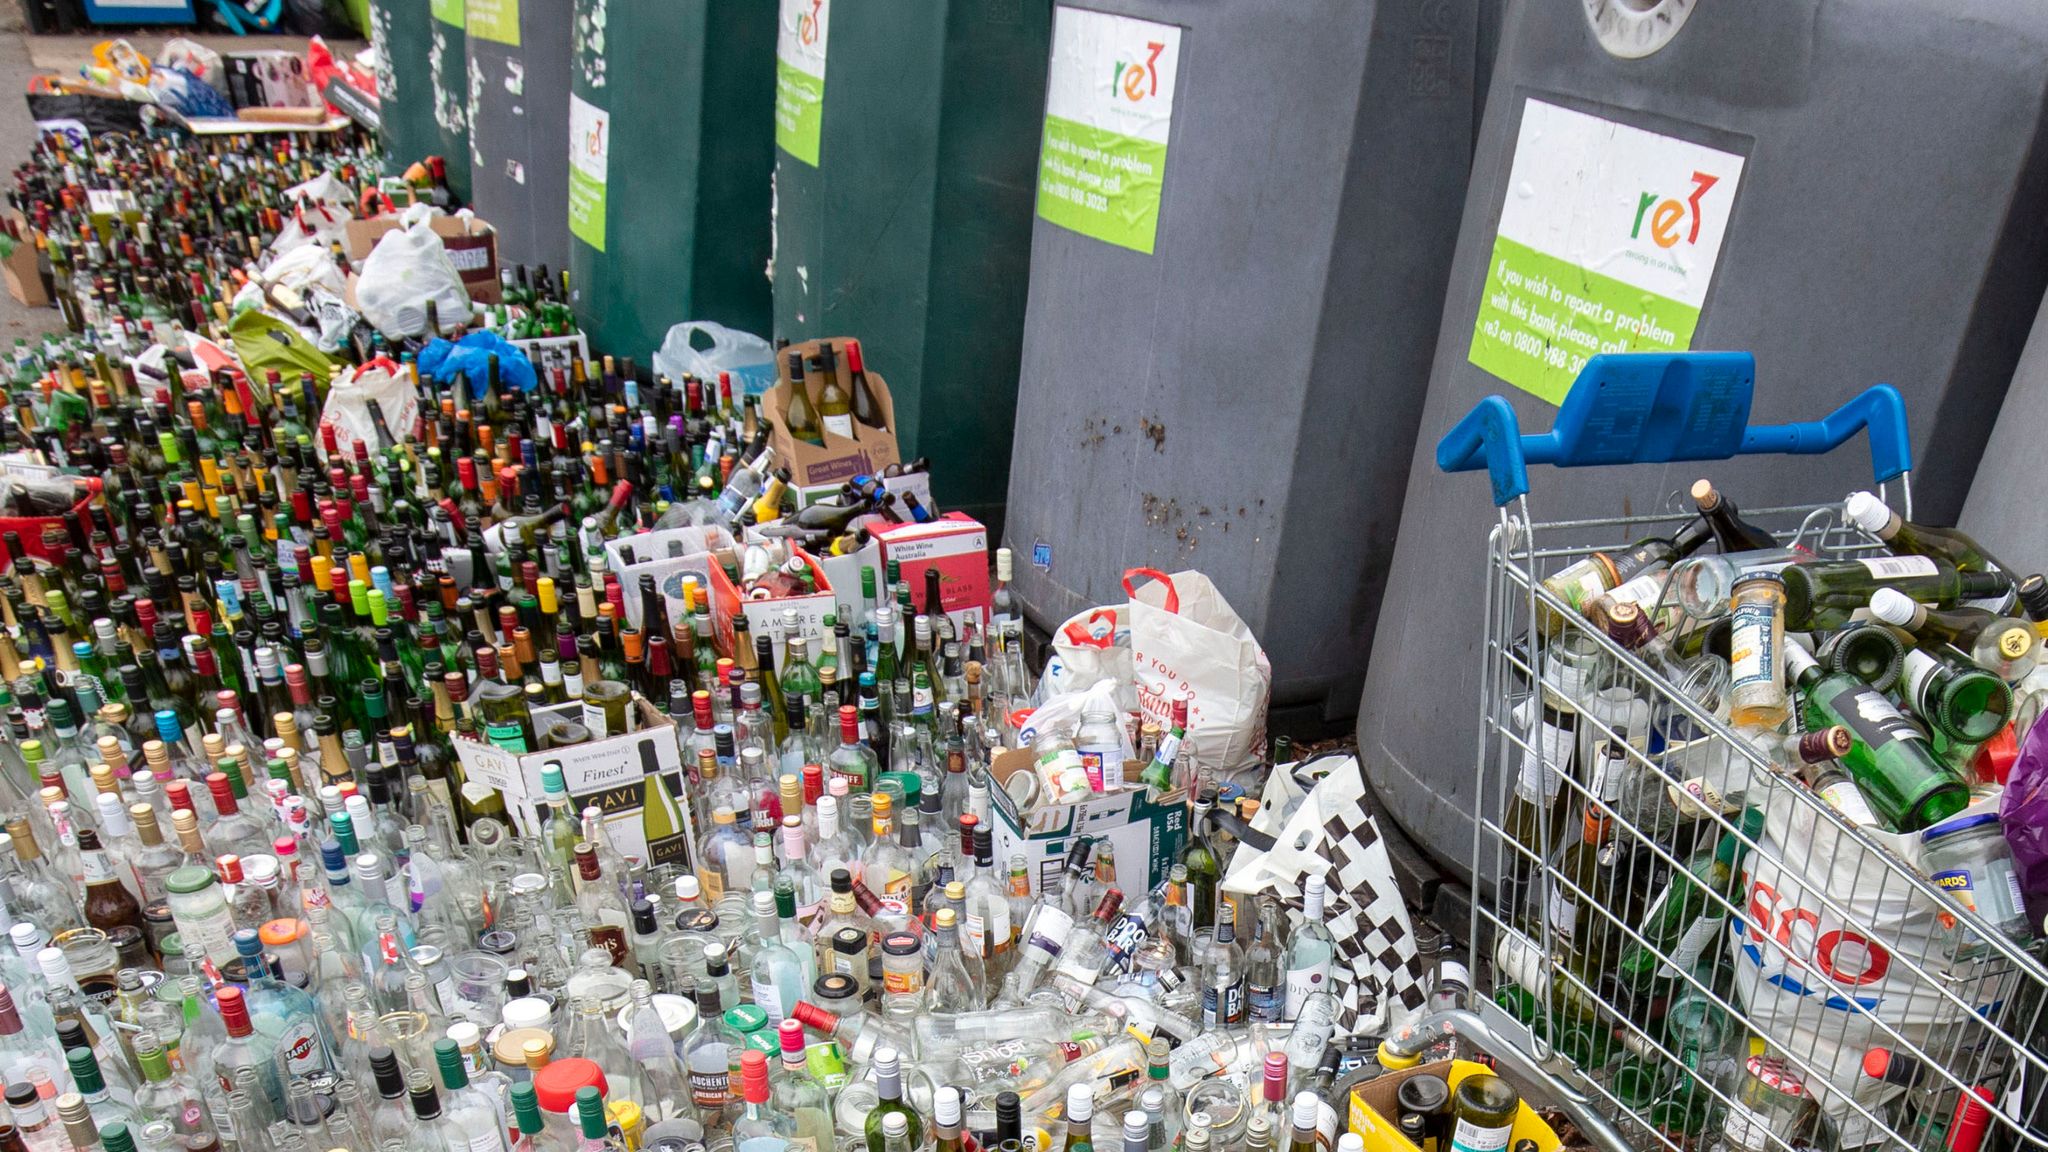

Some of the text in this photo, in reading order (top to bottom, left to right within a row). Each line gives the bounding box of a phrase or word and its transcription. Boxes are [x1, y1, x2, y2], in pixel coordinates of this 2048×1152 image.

[1112, 41, 1165, 101] re3
[1110, 152, 1152, 176] problem
[1631, 171, 1720, 249] re3
[1503, 270, 1522, 286] you
[1525, 275, 1547, 297] wish
[1551, 284, 1562, 302] to
[1564, 294, 1602, 318] report
[1604, 310, 1614, 323] a
[1615, 313, 1675, 346] problem
[1491, 291, 1509, 313] with
[1510, 297, 1527, 320] this
[1529, 305, 1557, 334] bank
[1558, 319, 1598, 349] please
[1484, 320, 1587, 374] re3 on 0800 988 30
[894, 542, 933, 553] White Wine
[895, 551, 926, 560] Australia
[767, 627, 818, 640] ITIA
[1151, 658, 1176, 680] YOU
[1179, 681, 1196, 700] DO
[583, 765, 624, 782] Finest
[589, 788, 636, 808] GAVI
[1166, 812, 1174, 832] USA
[1174, 810, 1182, 830] Red
[656, 844, 681, 857] GAVI
[1936, 875, 1967, 887] ARDS
[1115, 917, 1149, 943] DOO
[1747, 881, 1892, 985] SCO
[1228, 983, 1244, 1001] DO
[1228, 1001, 1243, 1017] BA
